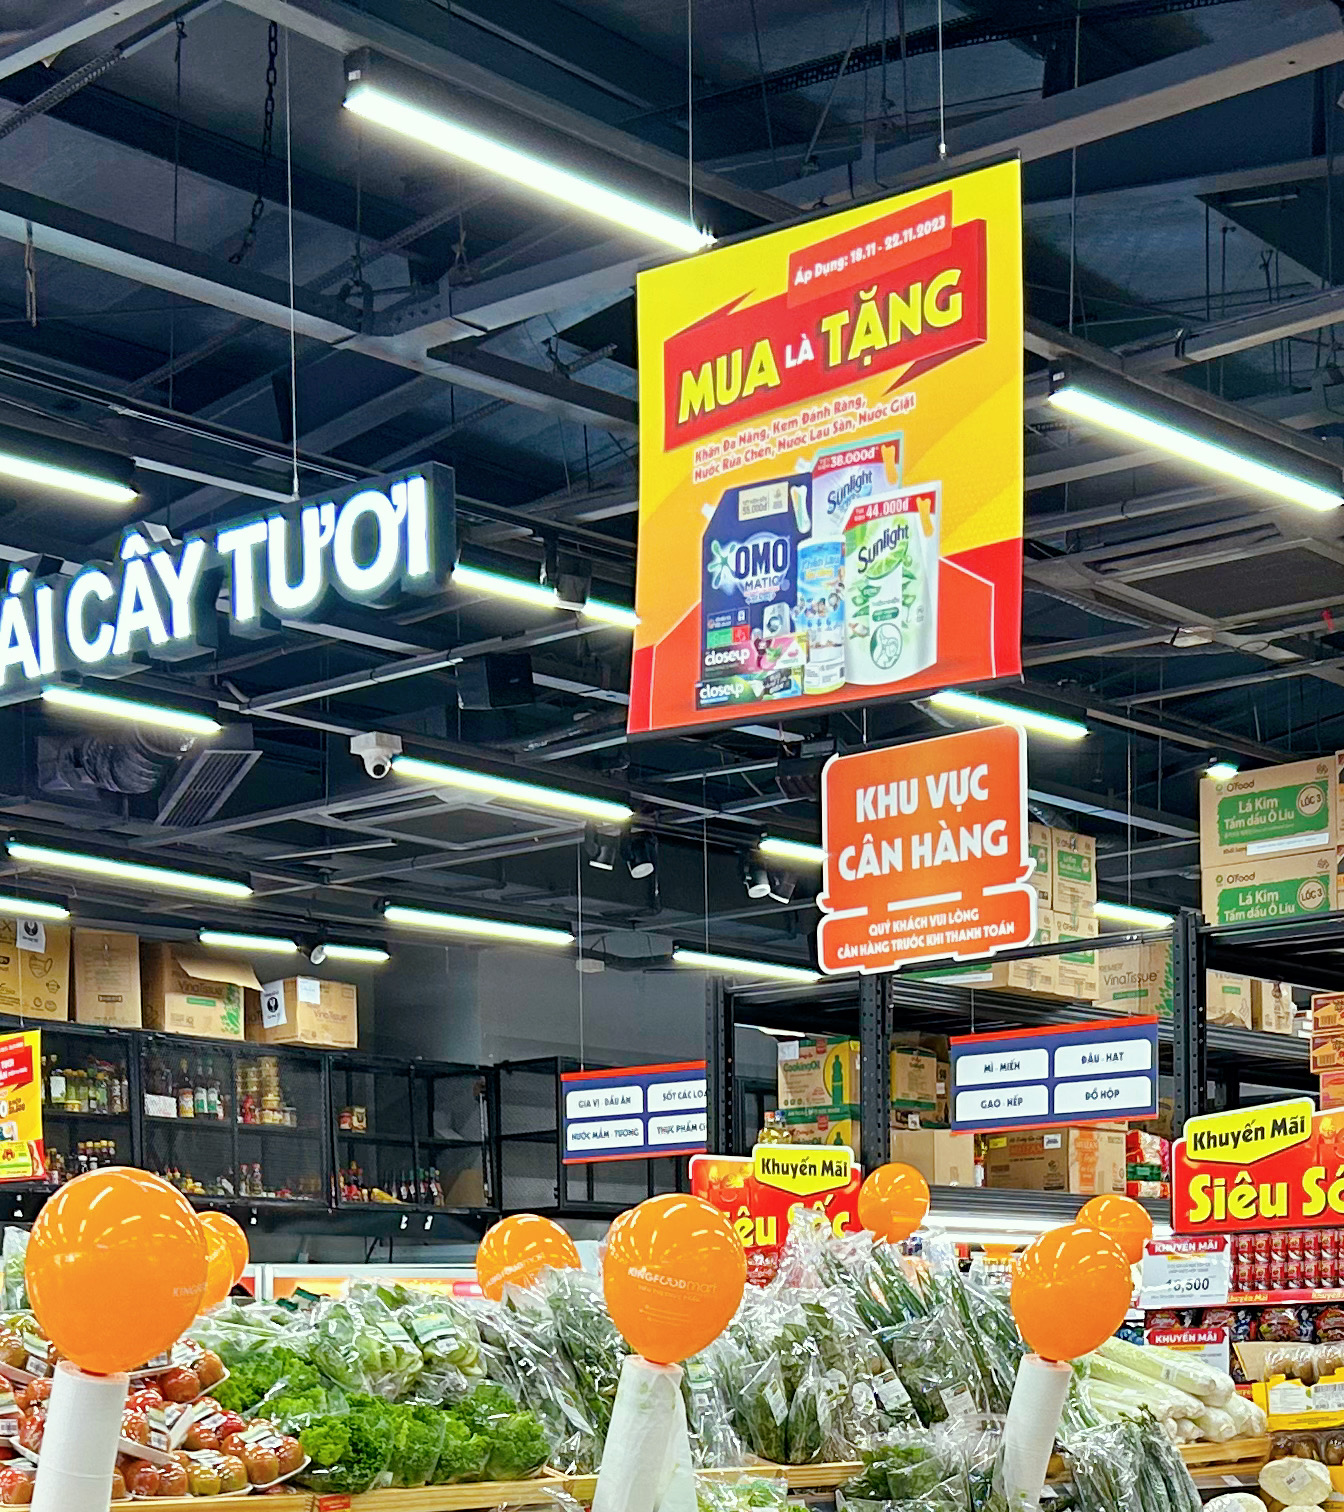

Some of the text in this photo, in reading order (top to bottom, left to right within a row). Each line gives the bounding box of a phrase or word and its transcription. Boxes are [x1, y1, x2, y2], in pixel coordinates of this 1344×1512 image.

[794, 215, 946, 286] Áp Dụng: 18.11 22.11.2023
[677, 269, 963, 425] MUA LÀ TẶNG
[773, 417, 798, 434] Kem
[802, 405, 830, 425] Đánh
[810, 426, 829, 442] Lau
[827, 470, 873, 514] Sunlight
[866, 498, 909, 517] 44.000đ
[735, 539, 789, 579] OMO
[858, 525, 909, 573] Sunlight
[66, 533, 207, 664] CÂY
[217, 474, 433, 624] TƯƠI
[745, 576, 780, 591] MATIC
[705, 646, 750, 667] closeup
[699, 679, 744, 700] closeup
[856, 764, 988, 823] KHU VỰC
[1239, 796, 1278, 813] Lá Kim
[1317, 795, 1321, 803] 3
[838, 819, 1009, 882] CÂN HÀNG
[1239, 890, 1279, 906] Lá Kim
[1318, 889, 1323, 897] 3
[869, 908, 979, 937] QUÝ KHÁCH VUI LÒNG
[837, 920, 1015, 960] CÂN HÀNG TRƯỚC KHI THANH TOÁN
[1104, 972, 1158, 985] VinaTissue
[1193, 1115, 1305, 1152] Khuyến Mãi
[760, 1149, 849, 1183] Khuyến Mãi
[1189, 1171, 1287, 1223] Siêu
[1198, 1237, 1219, 1251] MÃI
[1155, 1330, 1218, 1345] KHUYẾN MÃI
